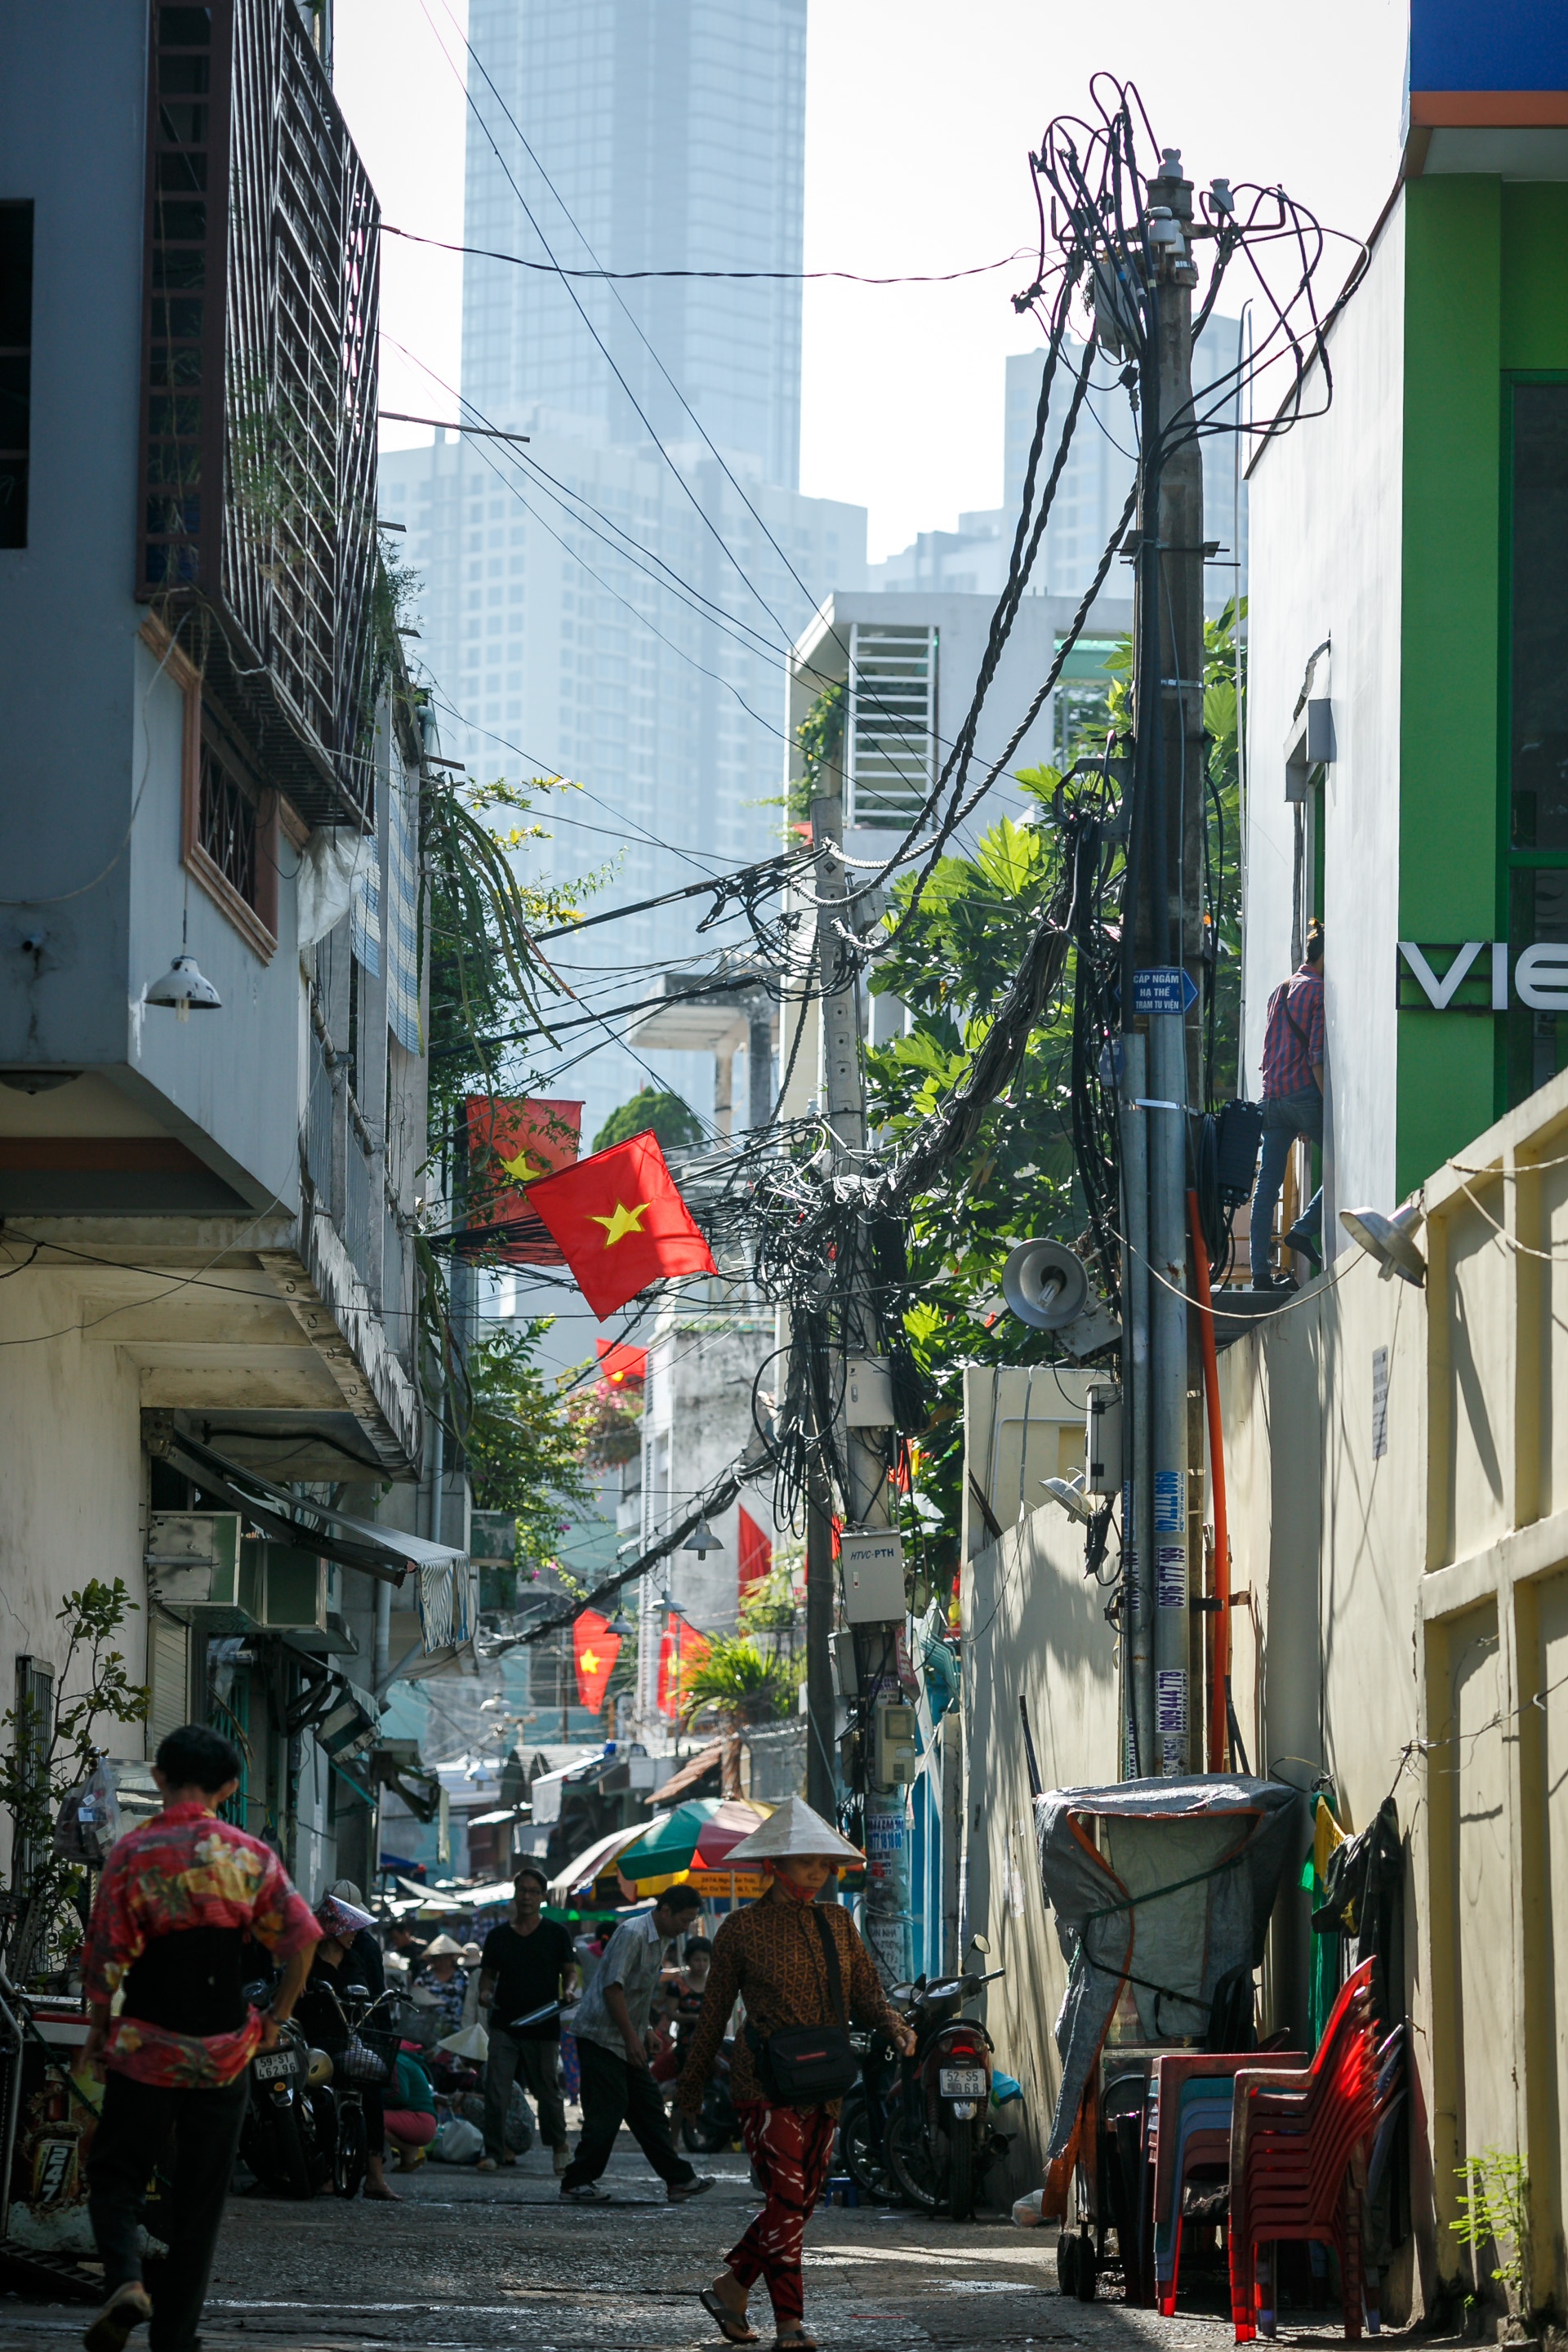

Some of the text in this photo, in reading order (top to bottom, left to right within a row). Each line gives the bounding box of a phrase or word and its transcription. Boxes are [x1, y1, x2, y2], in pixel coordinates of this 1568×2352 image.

[1139, 986, 1170, 998] HẠ THẾ
[1136, 1000, 1152, 1010] TRẠM
[1164, 999, 1178, 1010] VIỆN
[850, 1548, 894, 1561] HTVC-PTH
[1159, 1547, 1185, 1607] 0916.177.199
[1159, 1671, 1183, 1731] 0909.444.778
[260, 2053, 289, 2068] 59-S1
[947, 2071, 978, 2082] 52-S5
